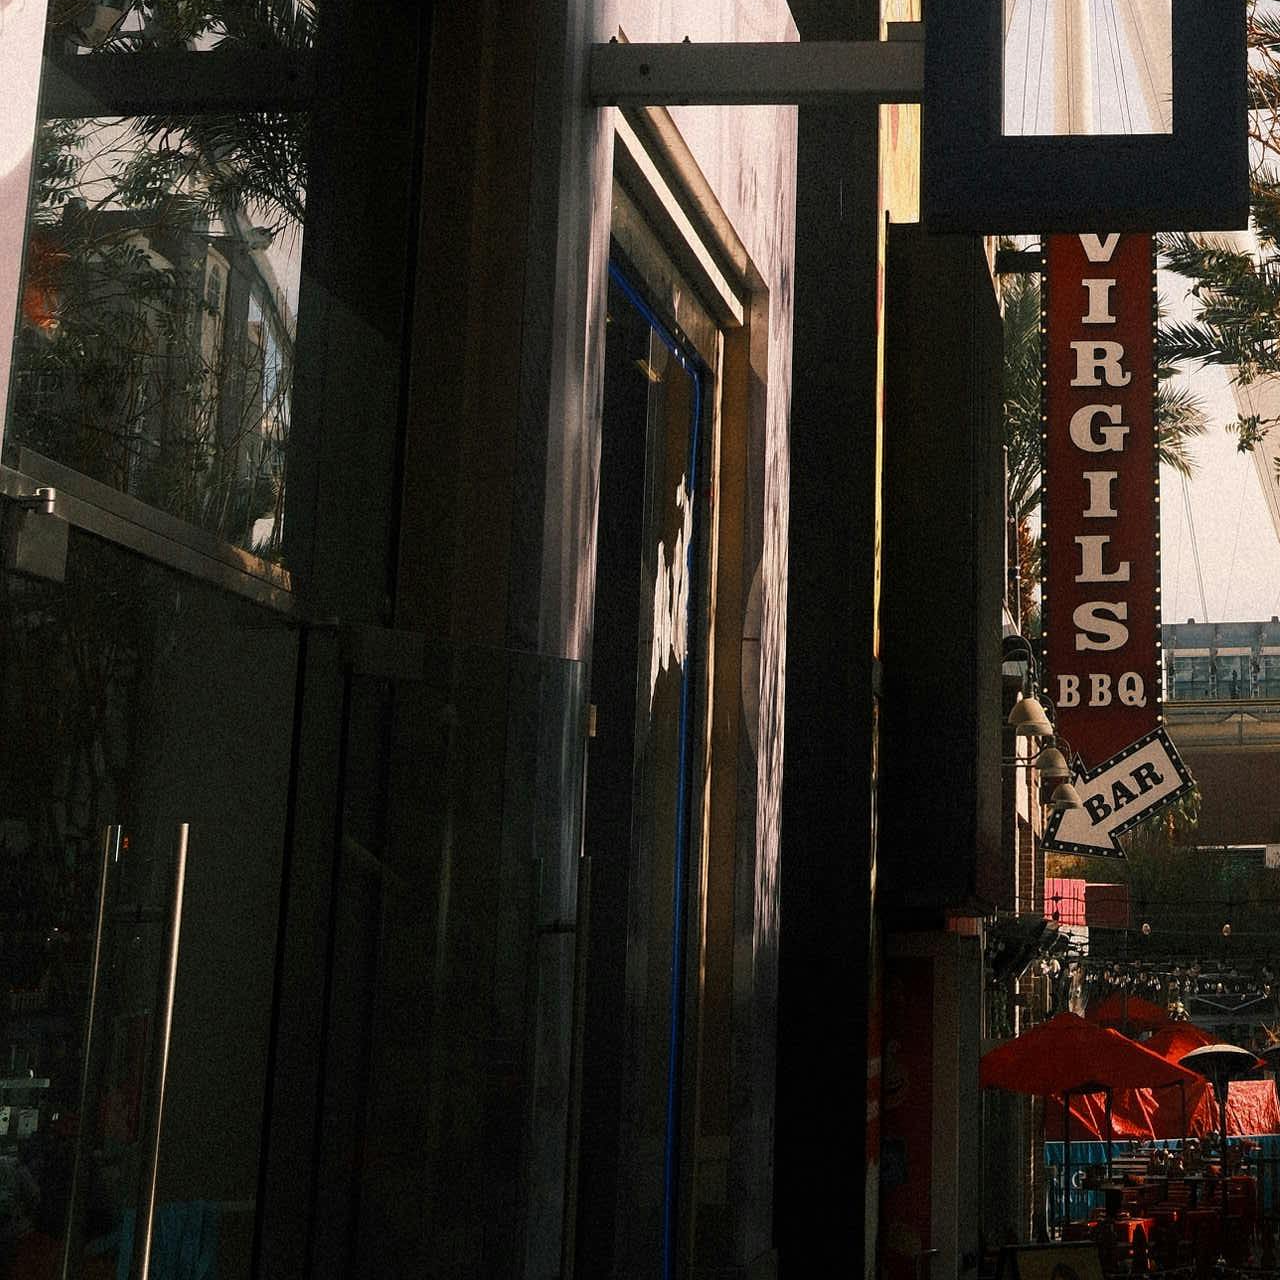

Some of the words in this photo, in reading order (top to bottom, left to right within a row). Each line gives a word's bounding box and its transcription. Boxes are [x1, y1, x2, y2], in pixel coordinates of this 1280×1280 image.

[1068, 233, 1131, 652] VIRGILS
[1056, 671, 1147, 710] BBQ
[1081, 761, 1164, 826] BAR
